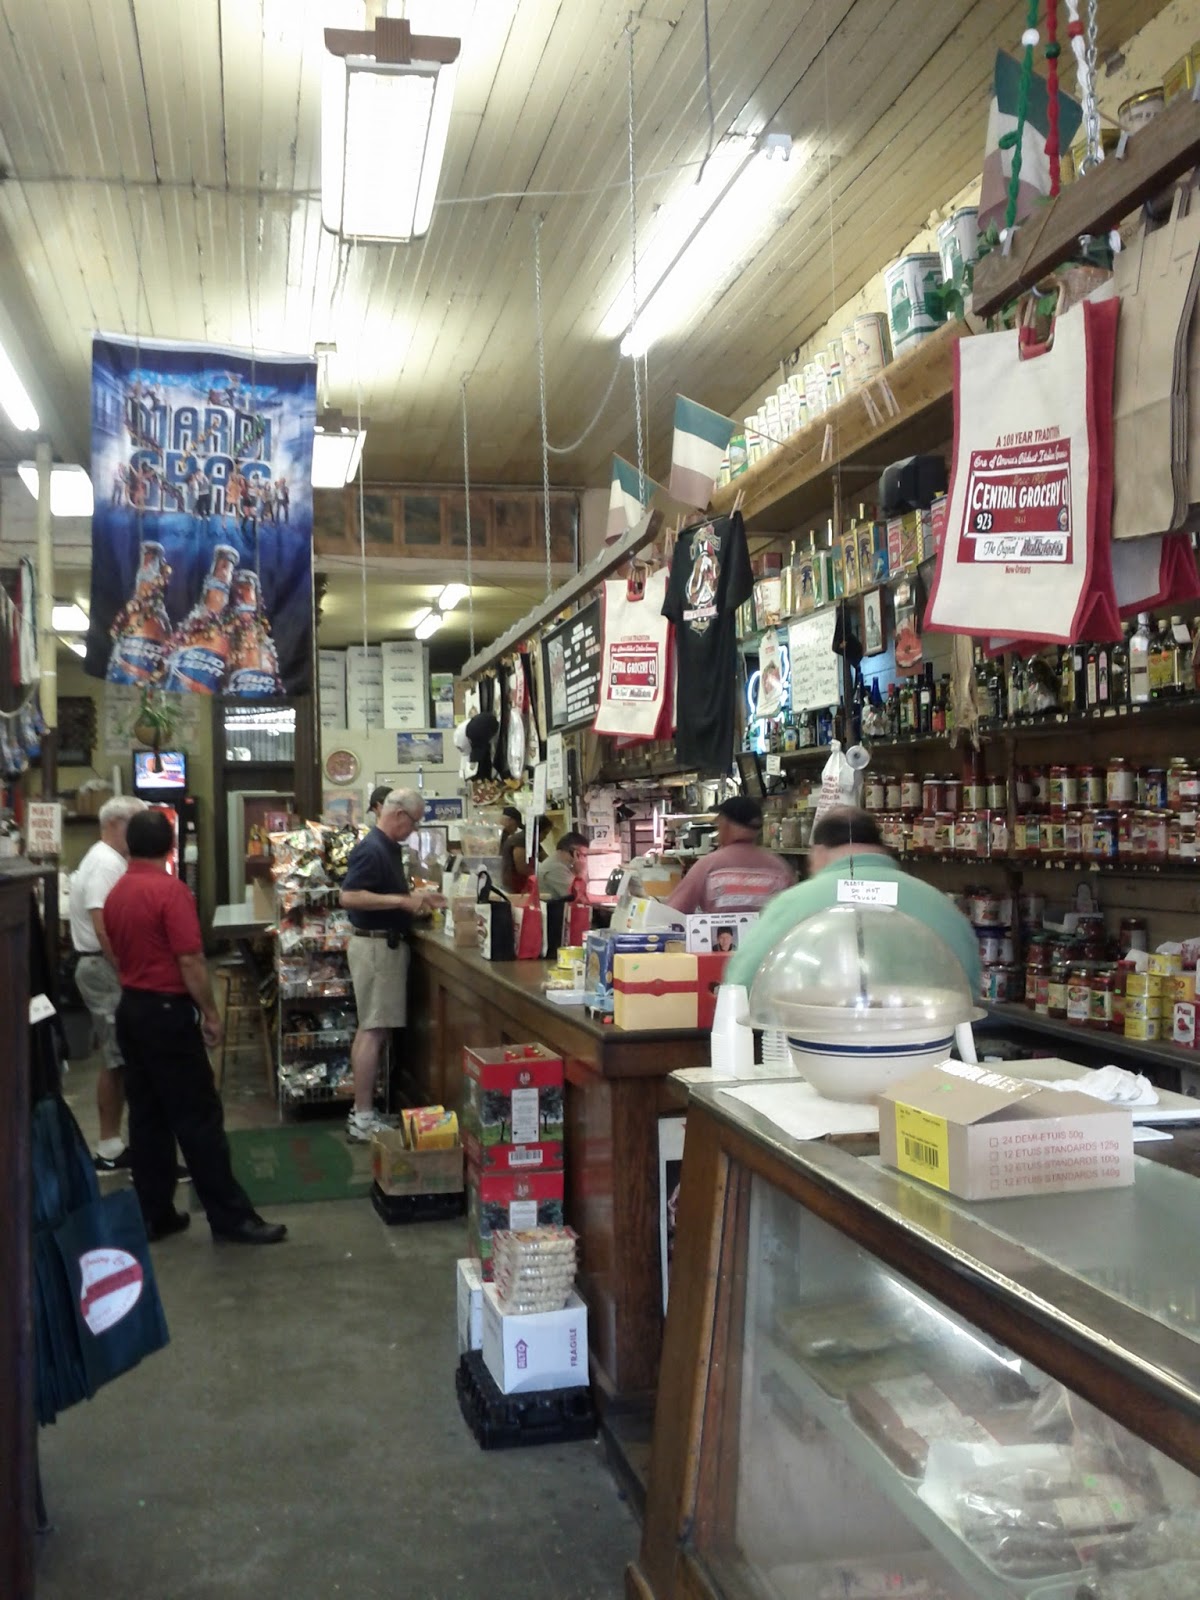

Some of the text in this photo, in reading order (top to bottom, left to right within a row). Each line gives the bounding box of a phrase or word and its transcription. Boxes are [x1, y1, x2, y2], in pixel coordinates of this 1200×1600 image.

[1014, 430, 1033, 445] YEAR
[973, 482, 1017, 510] CENTRAL
[1019, 479, 1061, 508] GROCERY
[976, 513, 993, 531] 923
[596, 830, 608, 839] 27
[1002, 1135, 1012, 1145] 24
[1068, 1130, 1084, 1139] 50g
[1004, 1150, 1013, 1158] 12
[1015, 1147, 1042, 1157] ETUIS
[1045, 1141, 1097, 1155] STANDARDS
[1004, 1164, 1013, 1173] 12
[1015, 1160, 1041, 1172] ETUIS
[1045, 1156, 1098, 1168] STANDARDS
[1004, 1178, 1014, 1187] 12
[1015, 1174, 1042, 1185] ETUIS
[1045, 1169, 1098, 1183] STANDARDS
[569, 1328, 578, 1367] FRAGILE
